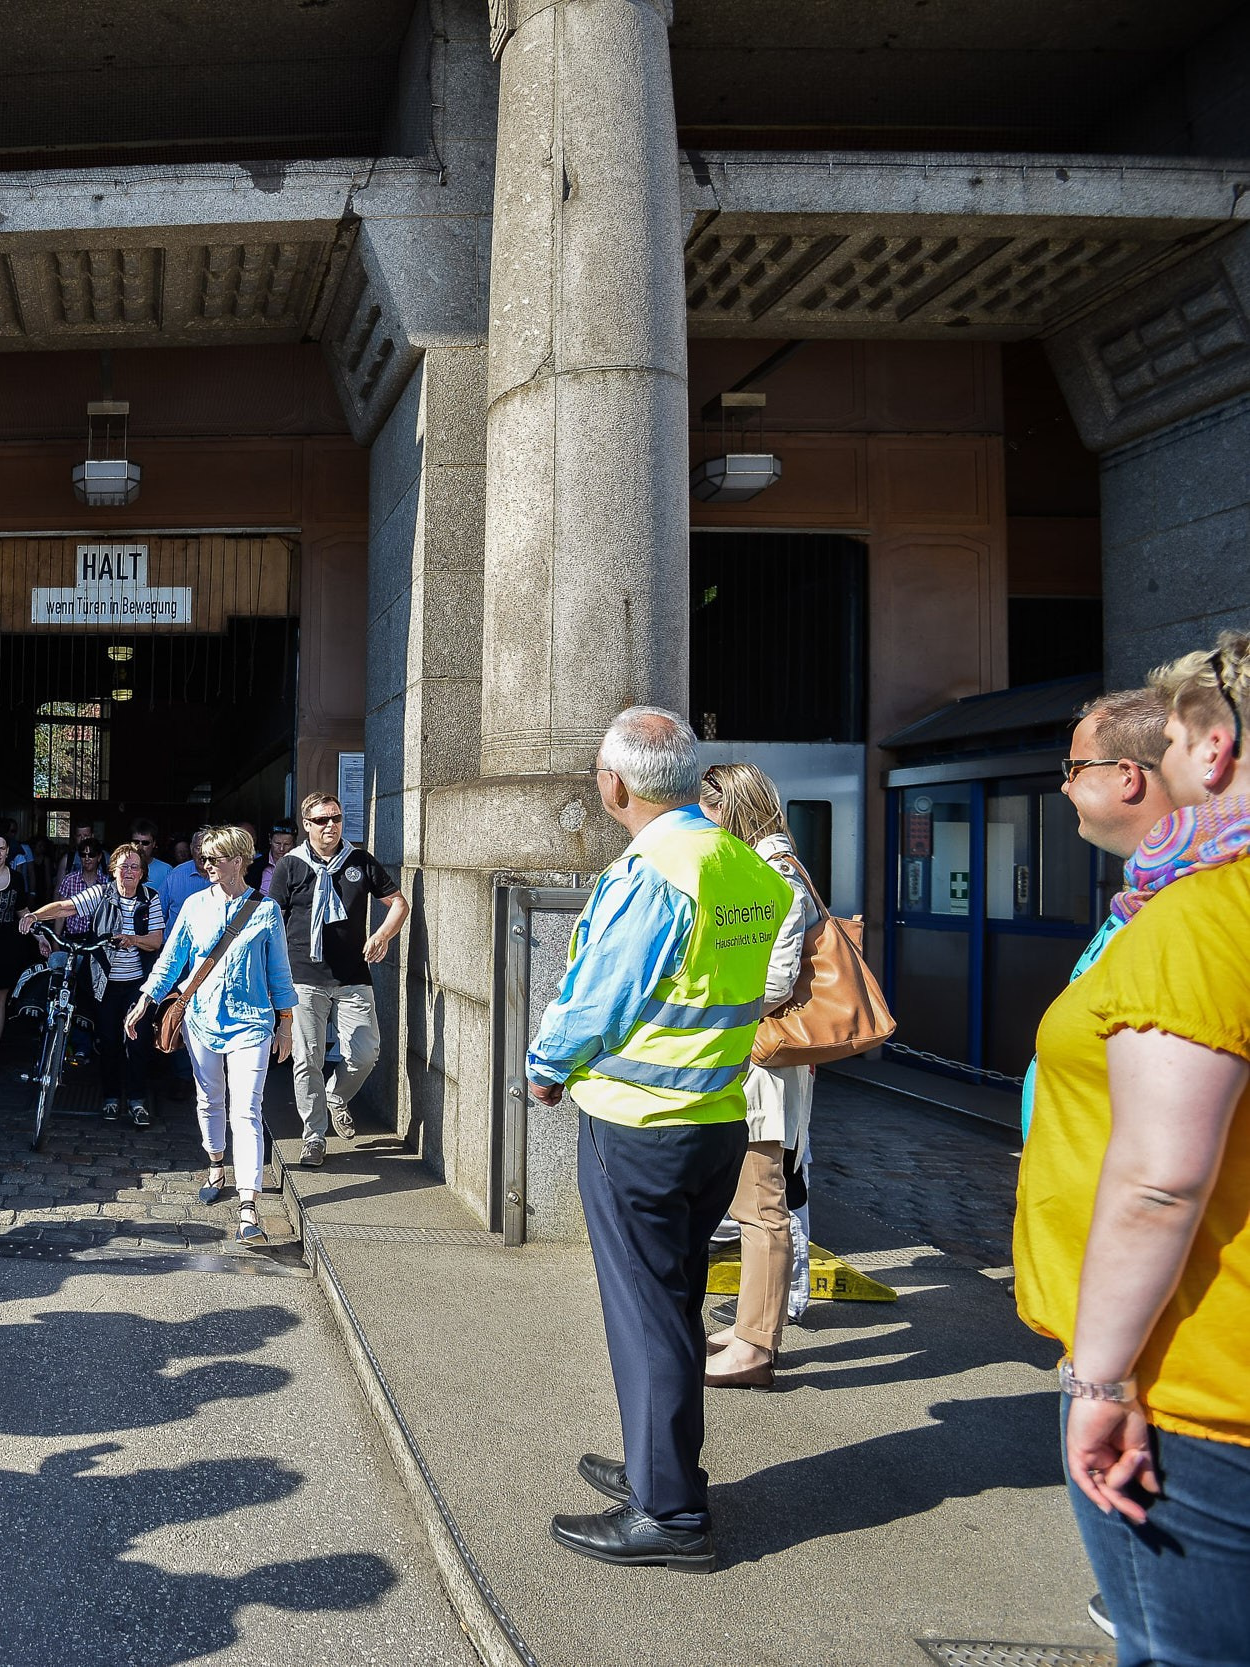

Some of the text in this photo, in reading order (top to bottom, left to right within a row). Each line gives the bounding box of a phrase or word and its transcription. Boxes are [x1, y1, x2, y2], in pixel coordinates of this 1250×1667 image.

[82, 552, 142, 580] HALT
[46, 596, 177, 619] wenn Türen in Bewegung
[751, 933, 758, 944] &
